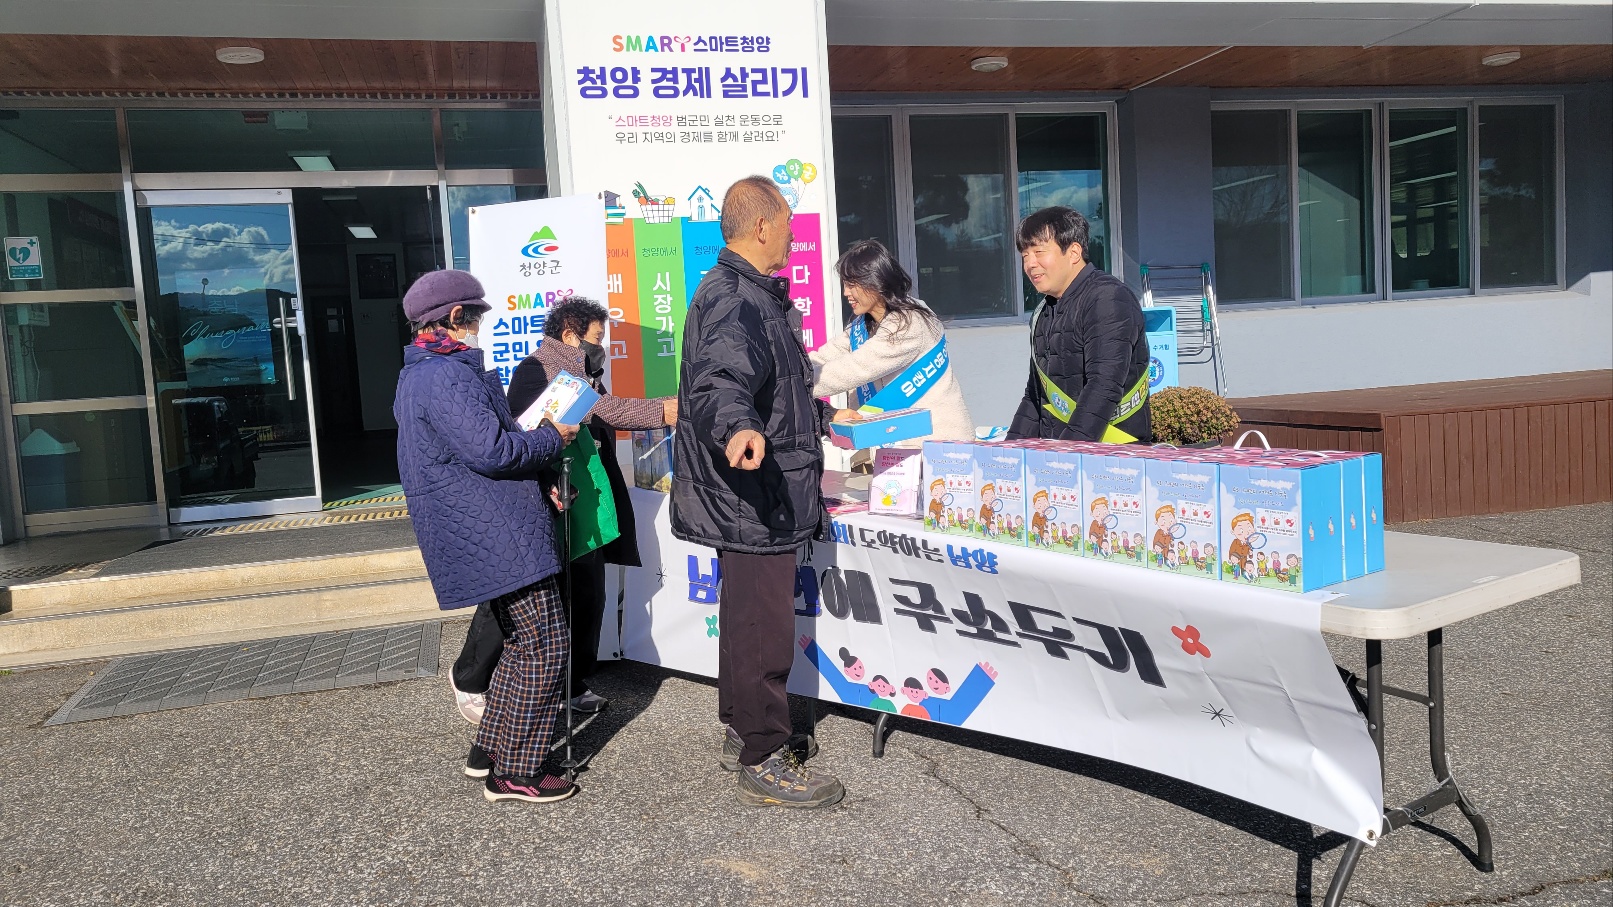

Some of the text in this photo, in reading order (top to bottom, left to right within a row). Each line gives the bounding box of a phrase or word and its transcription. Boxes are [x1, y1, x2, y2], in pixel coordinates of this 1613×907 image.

[693, 36, 771, 53] 스마트청양
[576, 66, 809, 99] 청양 경제 살리기
[676, 115, 710, 127] 범군민
[714, 114, 736, 127] 실천
[739, 114, 784, 126] 운동으로
[615, 131, 638, 144] 우리
[642, 131, 676, 144] 지역의
[680, 131, 714, 143] 경제를
[717, 131, 739, 143] 함께
[606, 248, 629, 259] 에서
[641, 246, 677, 258] 청양에서
[694, 245, 720, 256] 청양에
[790, 241, 816, 252] 양에서
[519, 259, 563, 278] 청양군
[652, 271, 677, 357] 시장가고
[493, 341, 529, 363] 군민
[859, 527, 944, 563] 도약하는
[946, 543, 999, 574] 남양
[888, 577, 1167, 688] 주소두기
